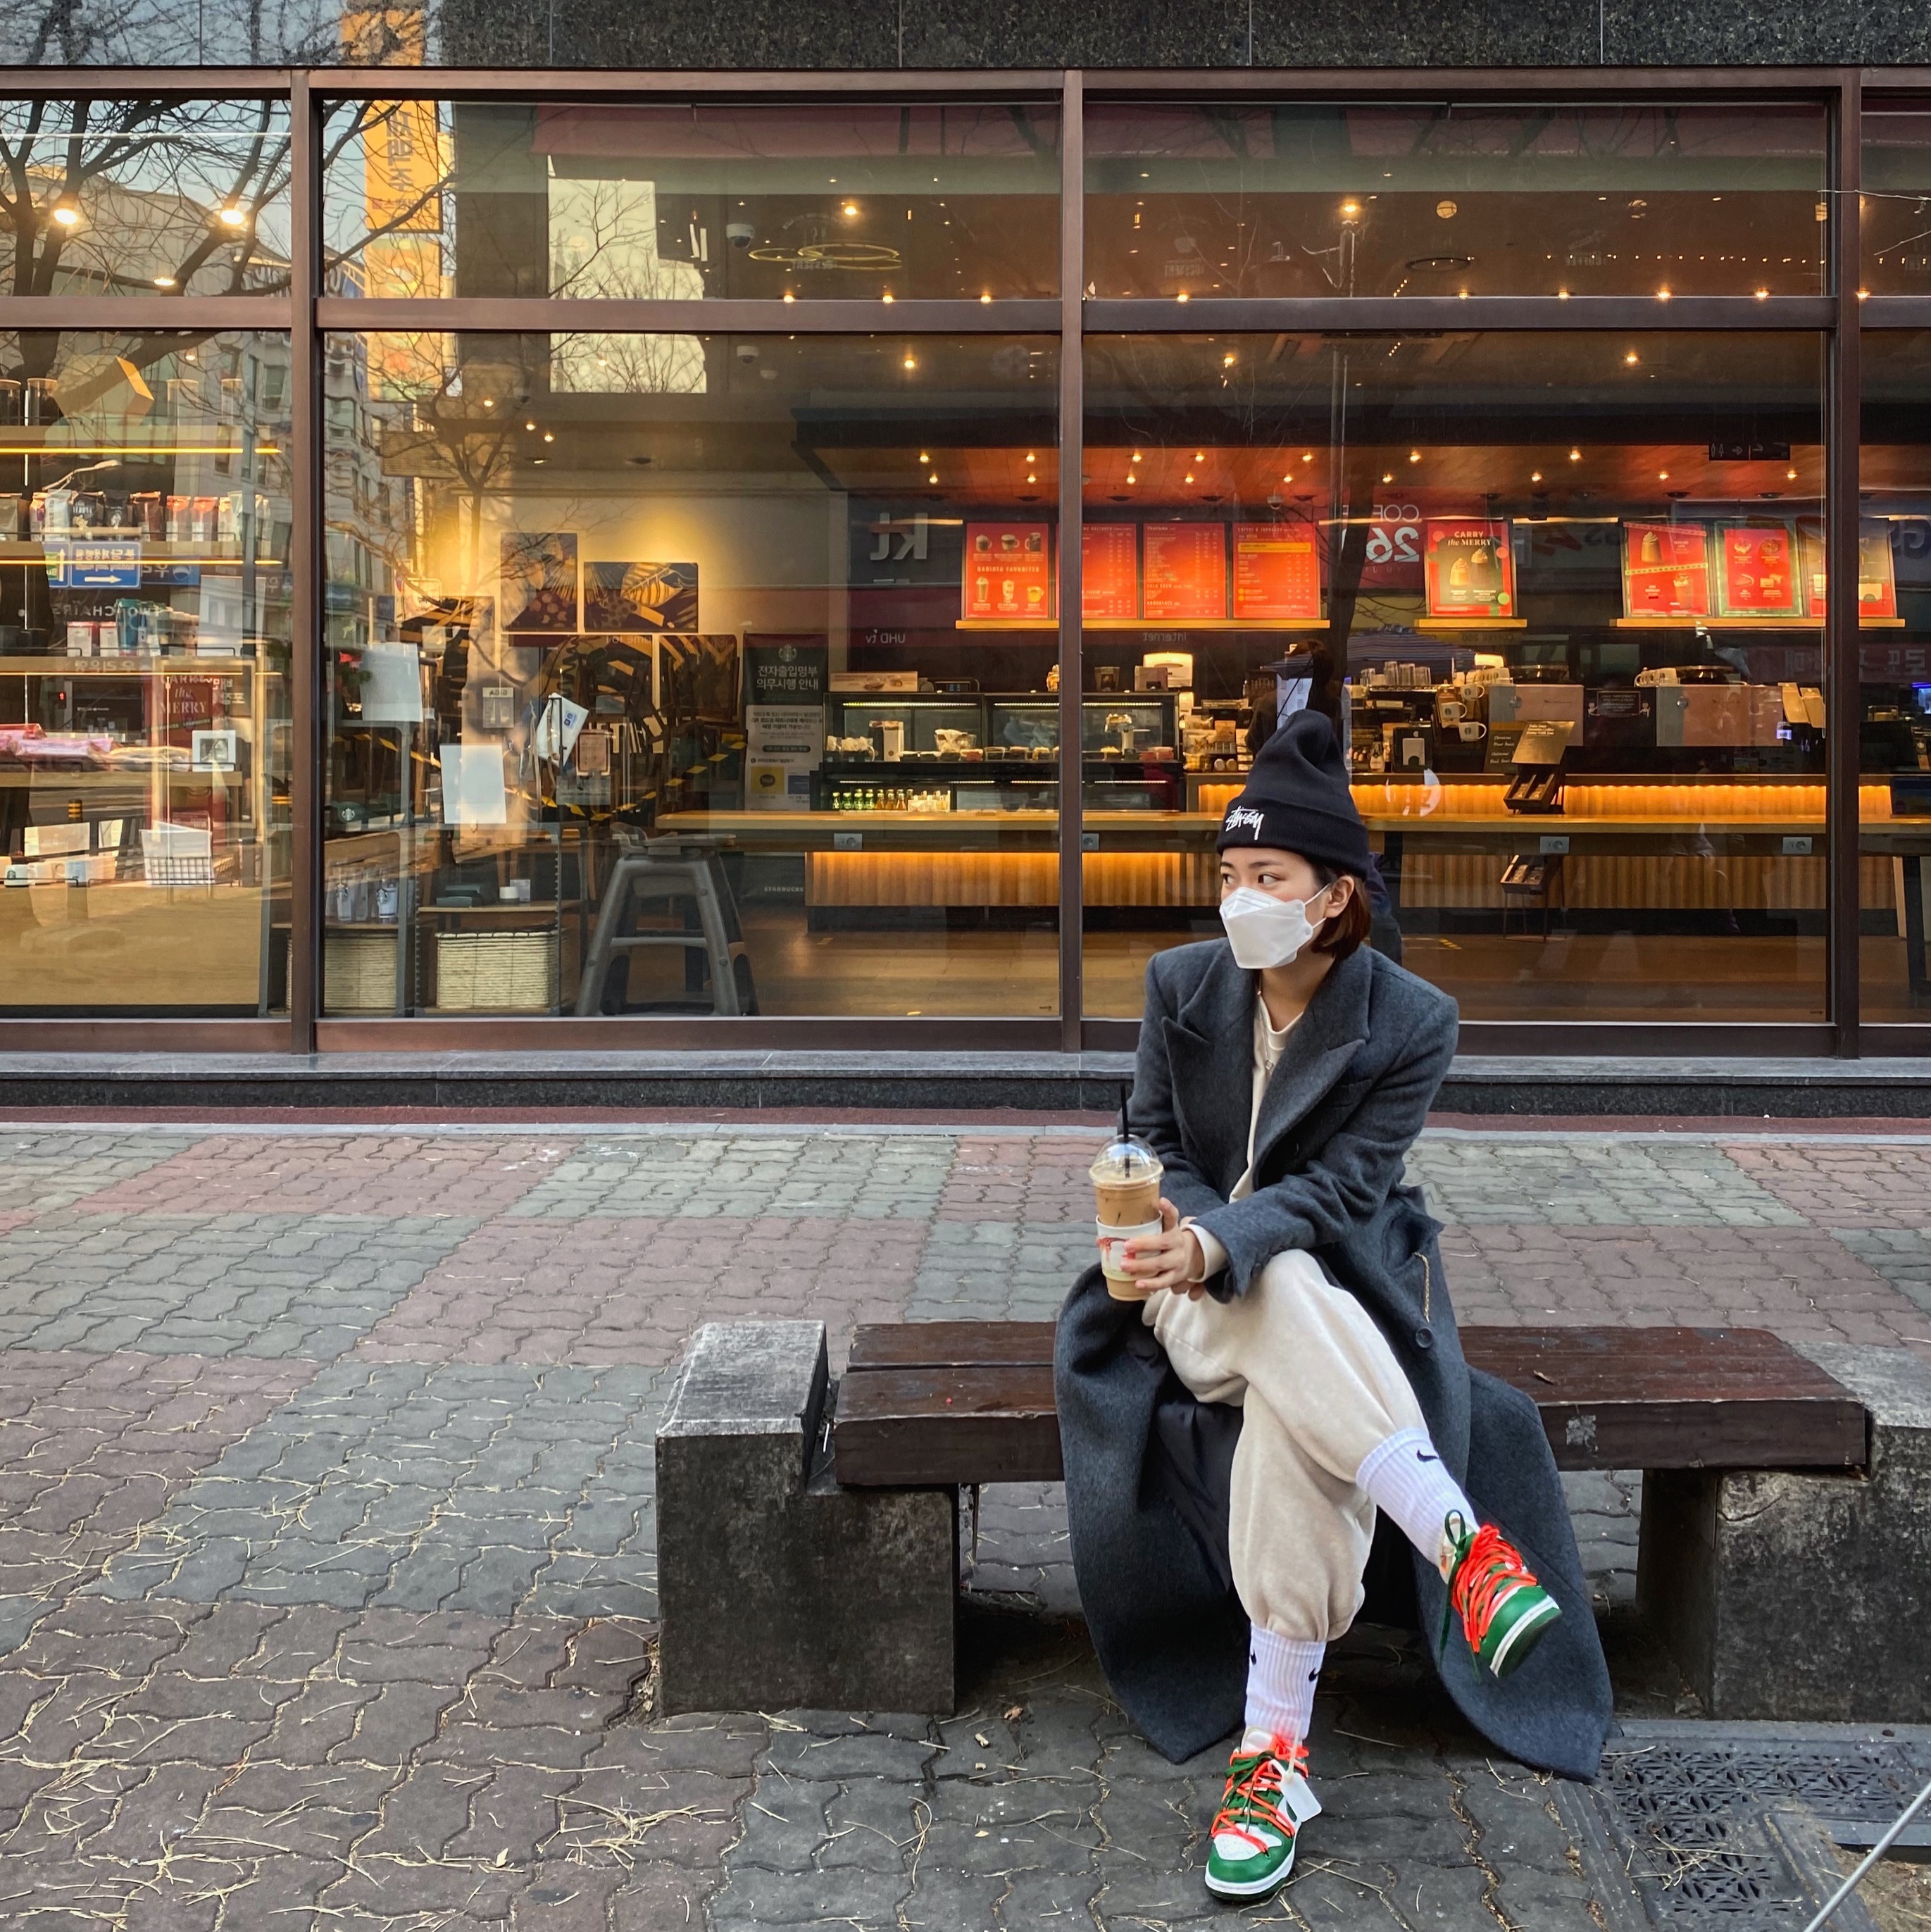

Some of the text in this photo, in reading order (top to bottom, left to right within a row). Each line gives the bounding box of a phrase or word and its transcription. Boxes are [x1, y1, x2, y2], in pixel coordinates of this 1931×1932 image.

[758, 665, 818, 678] 전자출입명부
[756, 678, 819, 690] 의무시행 안내
